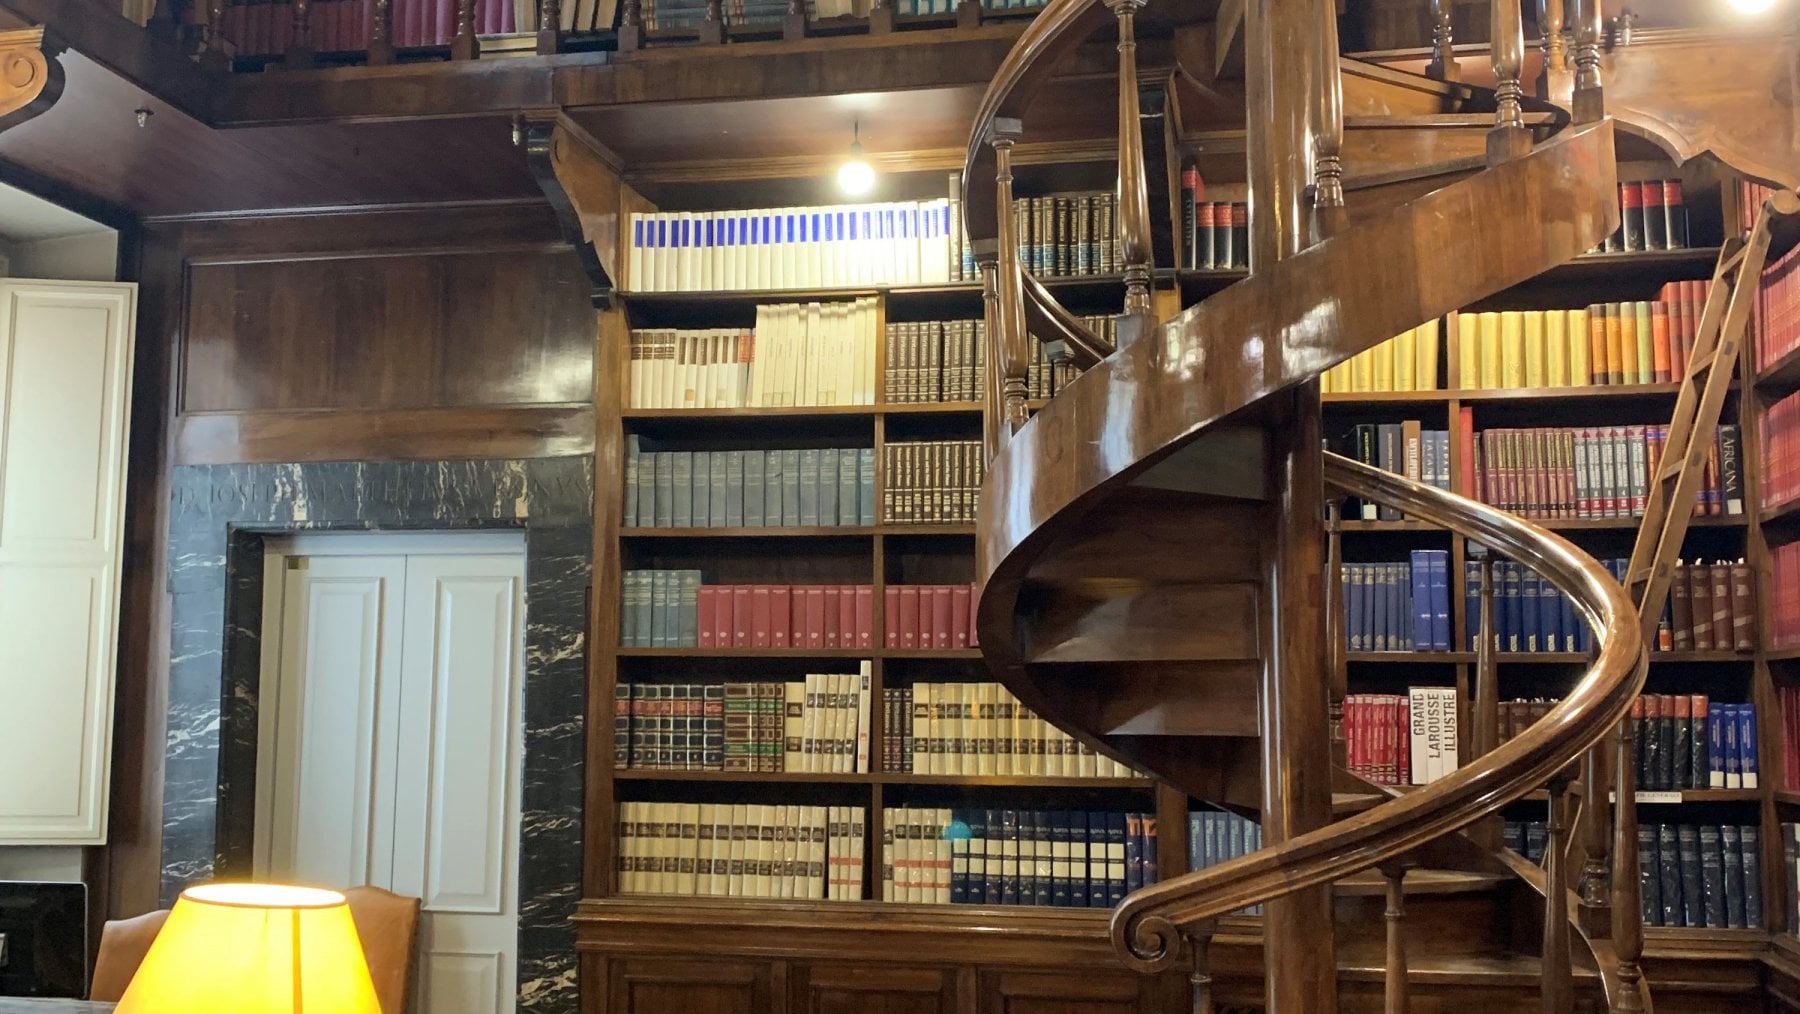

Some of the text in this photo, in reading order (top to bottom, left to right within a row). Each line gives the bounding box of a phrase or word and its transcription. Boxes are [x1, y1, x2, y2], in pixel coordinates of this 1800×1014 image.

[1722, 439, 1737, 493] AFRICANA
[1413, 693, 1424, 736] GRAND
[1427, 693, 1441, 758] LAROUSSE
[1443, 694, 1456, 751] ILLUSTRE
